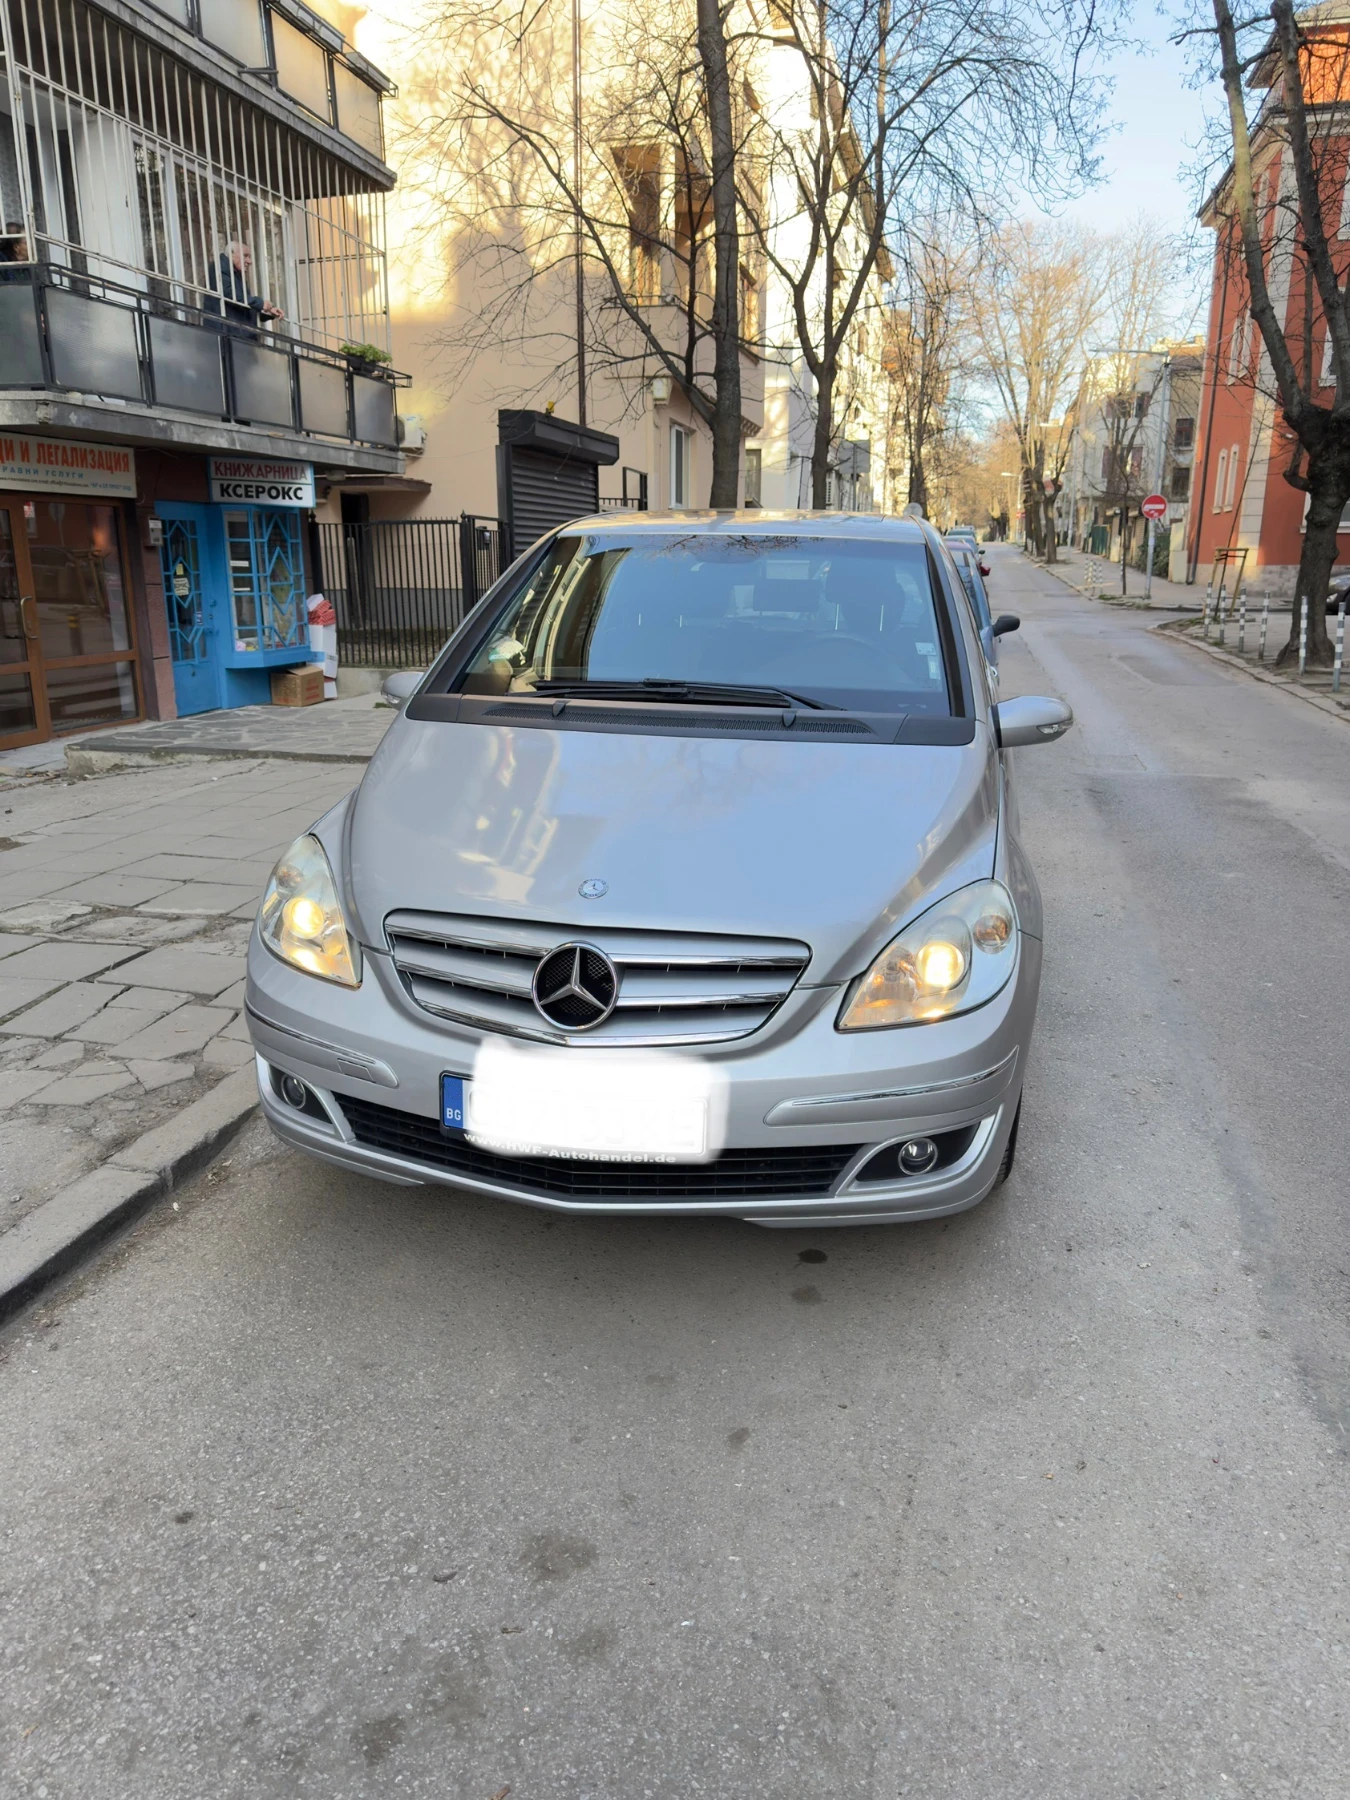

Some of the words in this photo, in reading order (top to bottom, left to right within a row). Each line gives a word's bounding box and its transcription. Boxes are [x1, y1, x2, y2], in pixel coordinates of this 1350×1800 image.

[20, 440, 30, 463] И
[36, 442, 130, 474] ЛЕГАЛИЗАЦИЯ
[2, 466, 39, 475] РАВНИ
[45, 469, 84, 479] УСЛУГИ
[214, 461, 308, 480] КНИЖАРНИЦА
[220, 483, 303, 500] КСЕРОКС
[446, 1107, 461, 1121] BG
